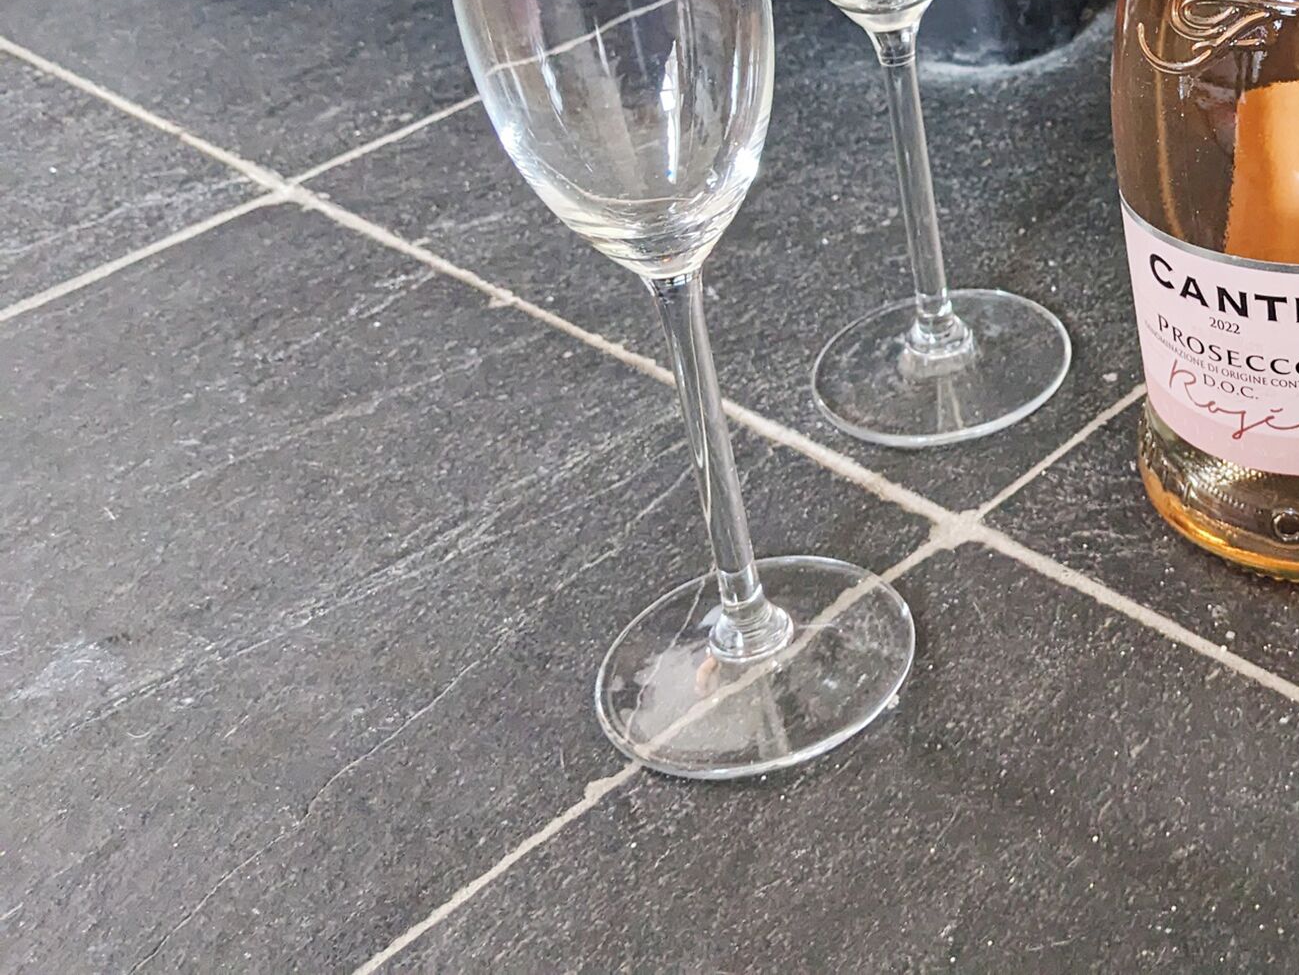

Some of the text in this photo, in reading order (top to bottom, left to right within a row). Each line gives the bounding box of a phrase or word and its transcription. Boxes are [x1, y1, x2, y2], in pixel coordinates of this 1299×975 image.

[1209, 317, 1240, 335] 2022
[1203, 373, 1259, 399] D.O.C.
[1207, 363, 1219, 374] DI
[1221, 367, 1268, 386] ORIGINE
